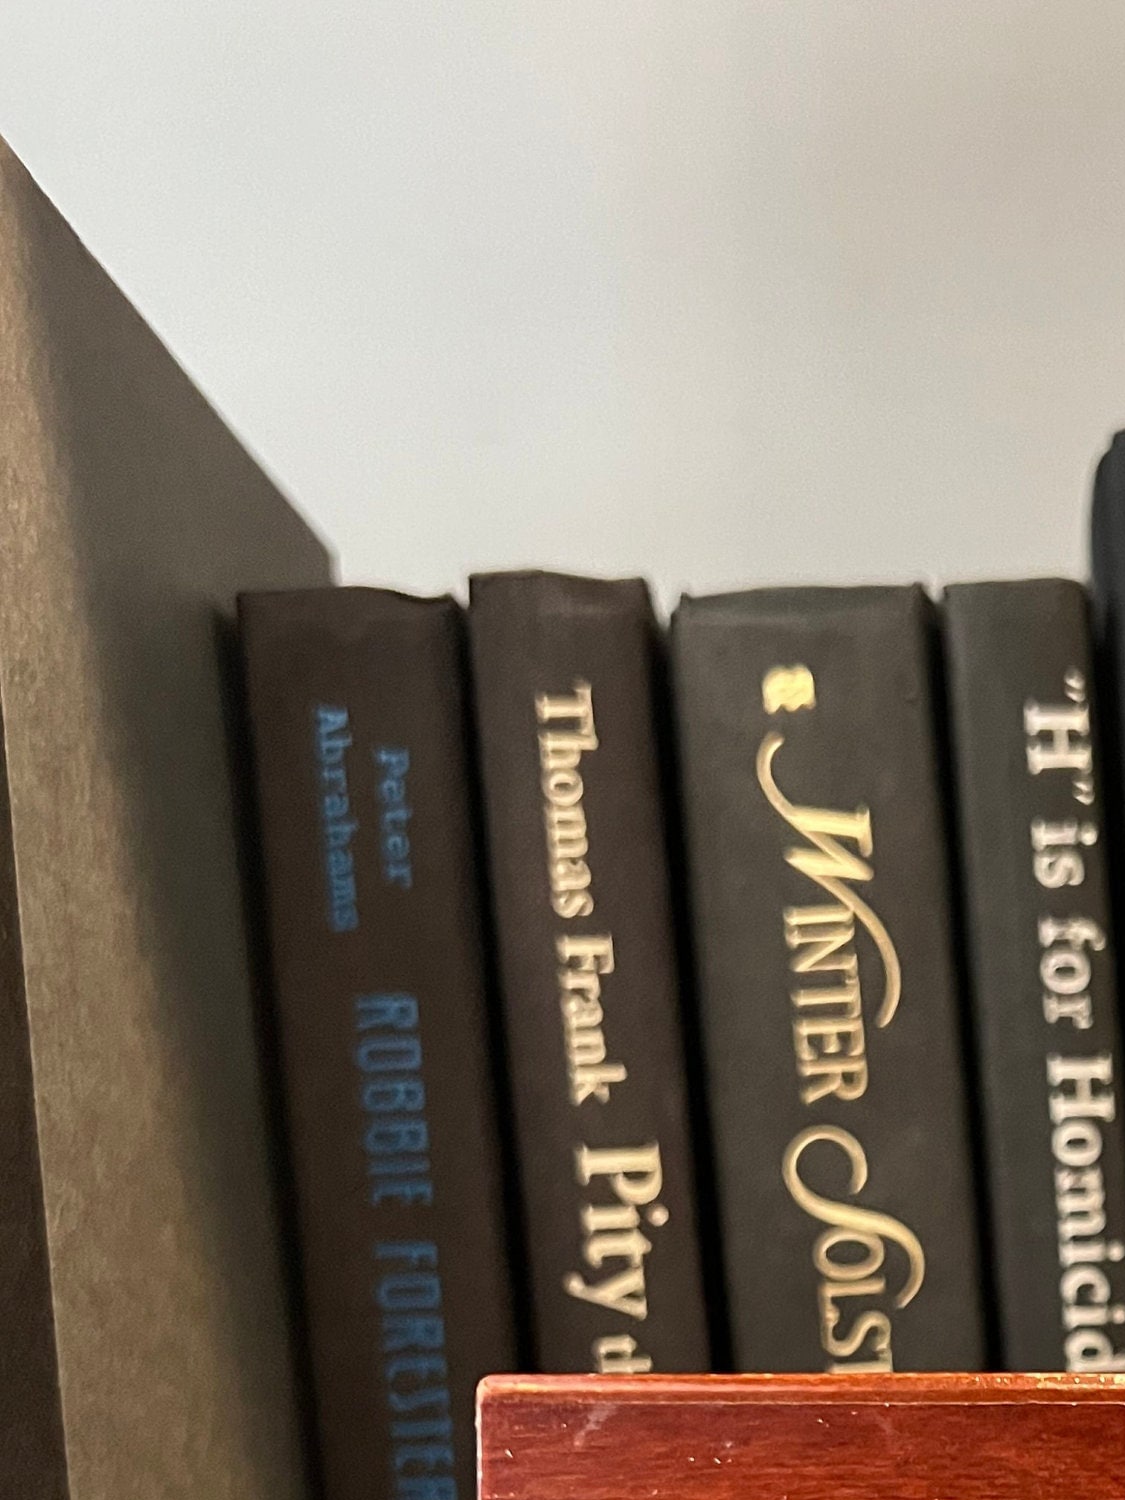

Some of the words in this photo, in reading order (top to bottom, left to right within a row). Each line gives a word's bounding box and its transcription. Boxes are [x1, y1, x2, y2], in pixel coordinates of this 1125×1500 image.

[313, 703, 359, 932] Abrahams
[373, 745, 413, 888] Peter
[534, 684, 599, 920] Thomas
[1029, 820, 1099, 890] is
[755, 733, 902, 1105] WINTER
[1037, 916, 1106, 1031] for
[354, 991, 435, 1204] ROBBIE
[555, 934, 628, 1106] Frank
[566, 1144, 670, 1320] Pity
